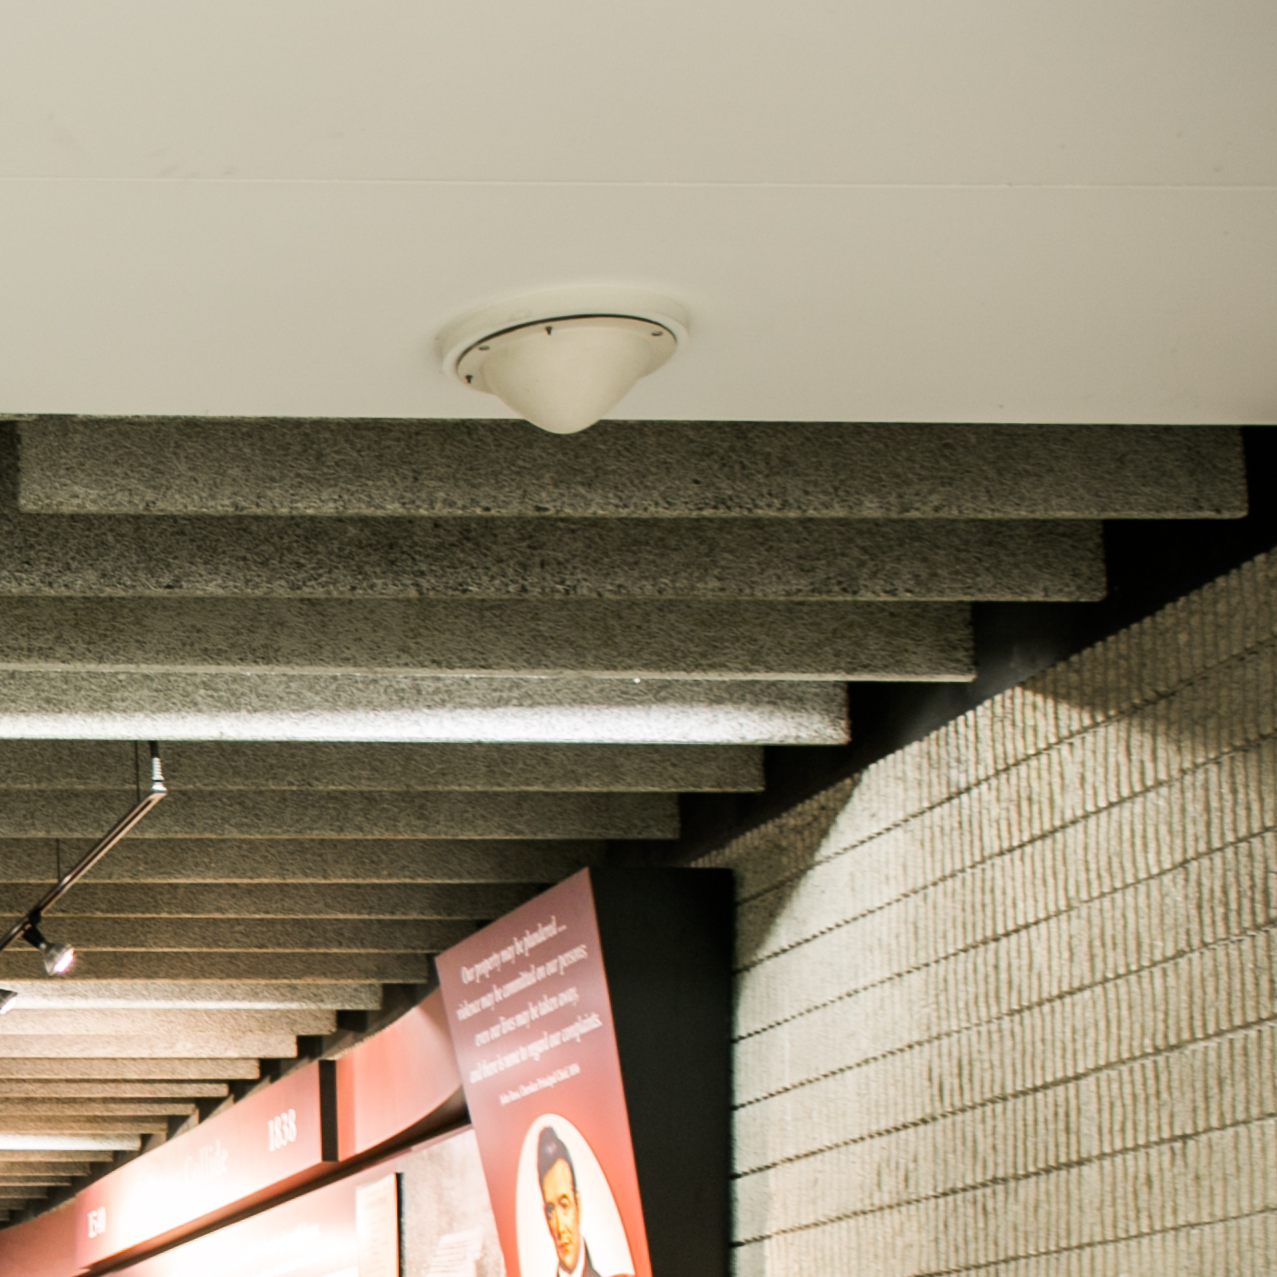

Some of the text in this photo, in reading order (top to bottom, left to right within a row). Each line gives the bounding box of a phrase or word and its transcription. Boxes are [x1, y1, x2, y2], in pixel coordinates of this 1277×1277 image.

[86, 1108, 297, 1240] 1540 Collide 1838
